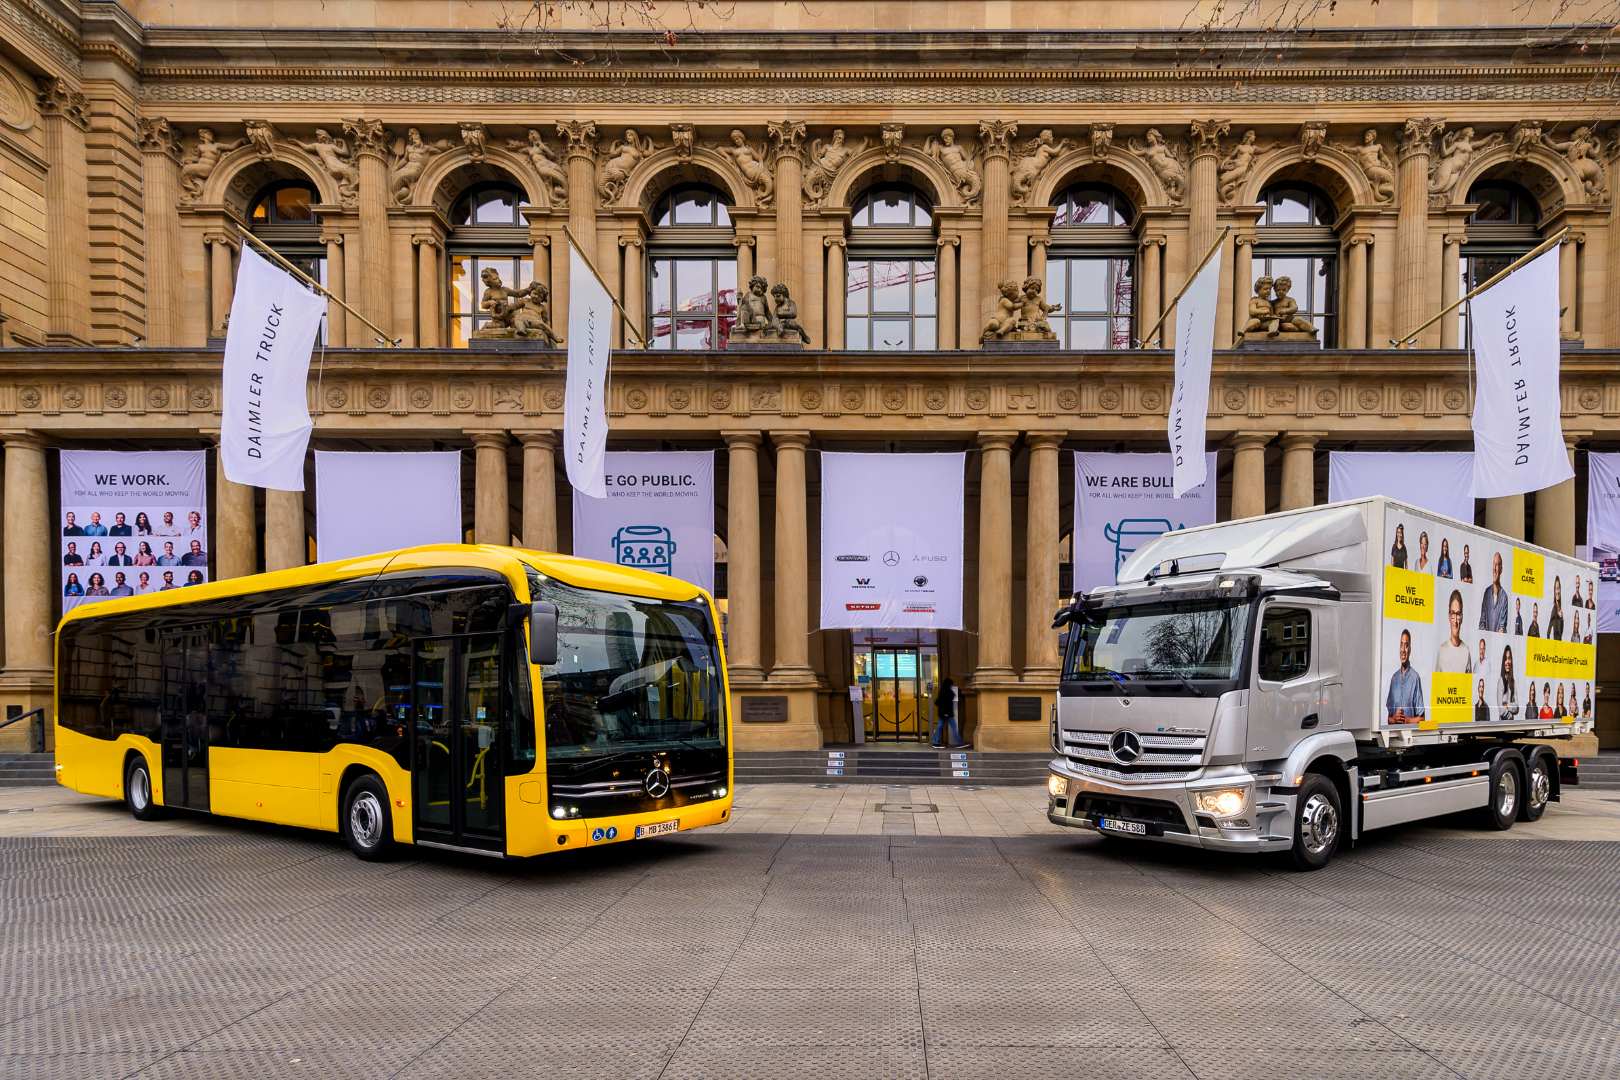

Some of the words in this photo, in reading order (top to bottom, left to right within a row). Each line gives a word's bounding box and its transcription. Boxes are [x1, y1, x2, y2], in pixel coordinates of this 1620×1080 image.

[248, 372, 264, 459] DAIMLER
[256, 302, 284, 362] TRUCK
[577, 378, 592, 464] DAIMLER
[94, 474, 118, 486] WE
[121, 474, 170, 486] WORK.
[617, 474, 638, 487] GO
[642, 474, 696, 487] PUBLIC.
[1085, 475, 1108, 487] WE
[1111, 476, 1139, 488] ARE
[1525, 567, 1534, 576] WE
[1405, 585, 1417, 595] WE
[1395, 594, 1426, 607] DELIVER.
[1447, 687, 1458, 695] WE
